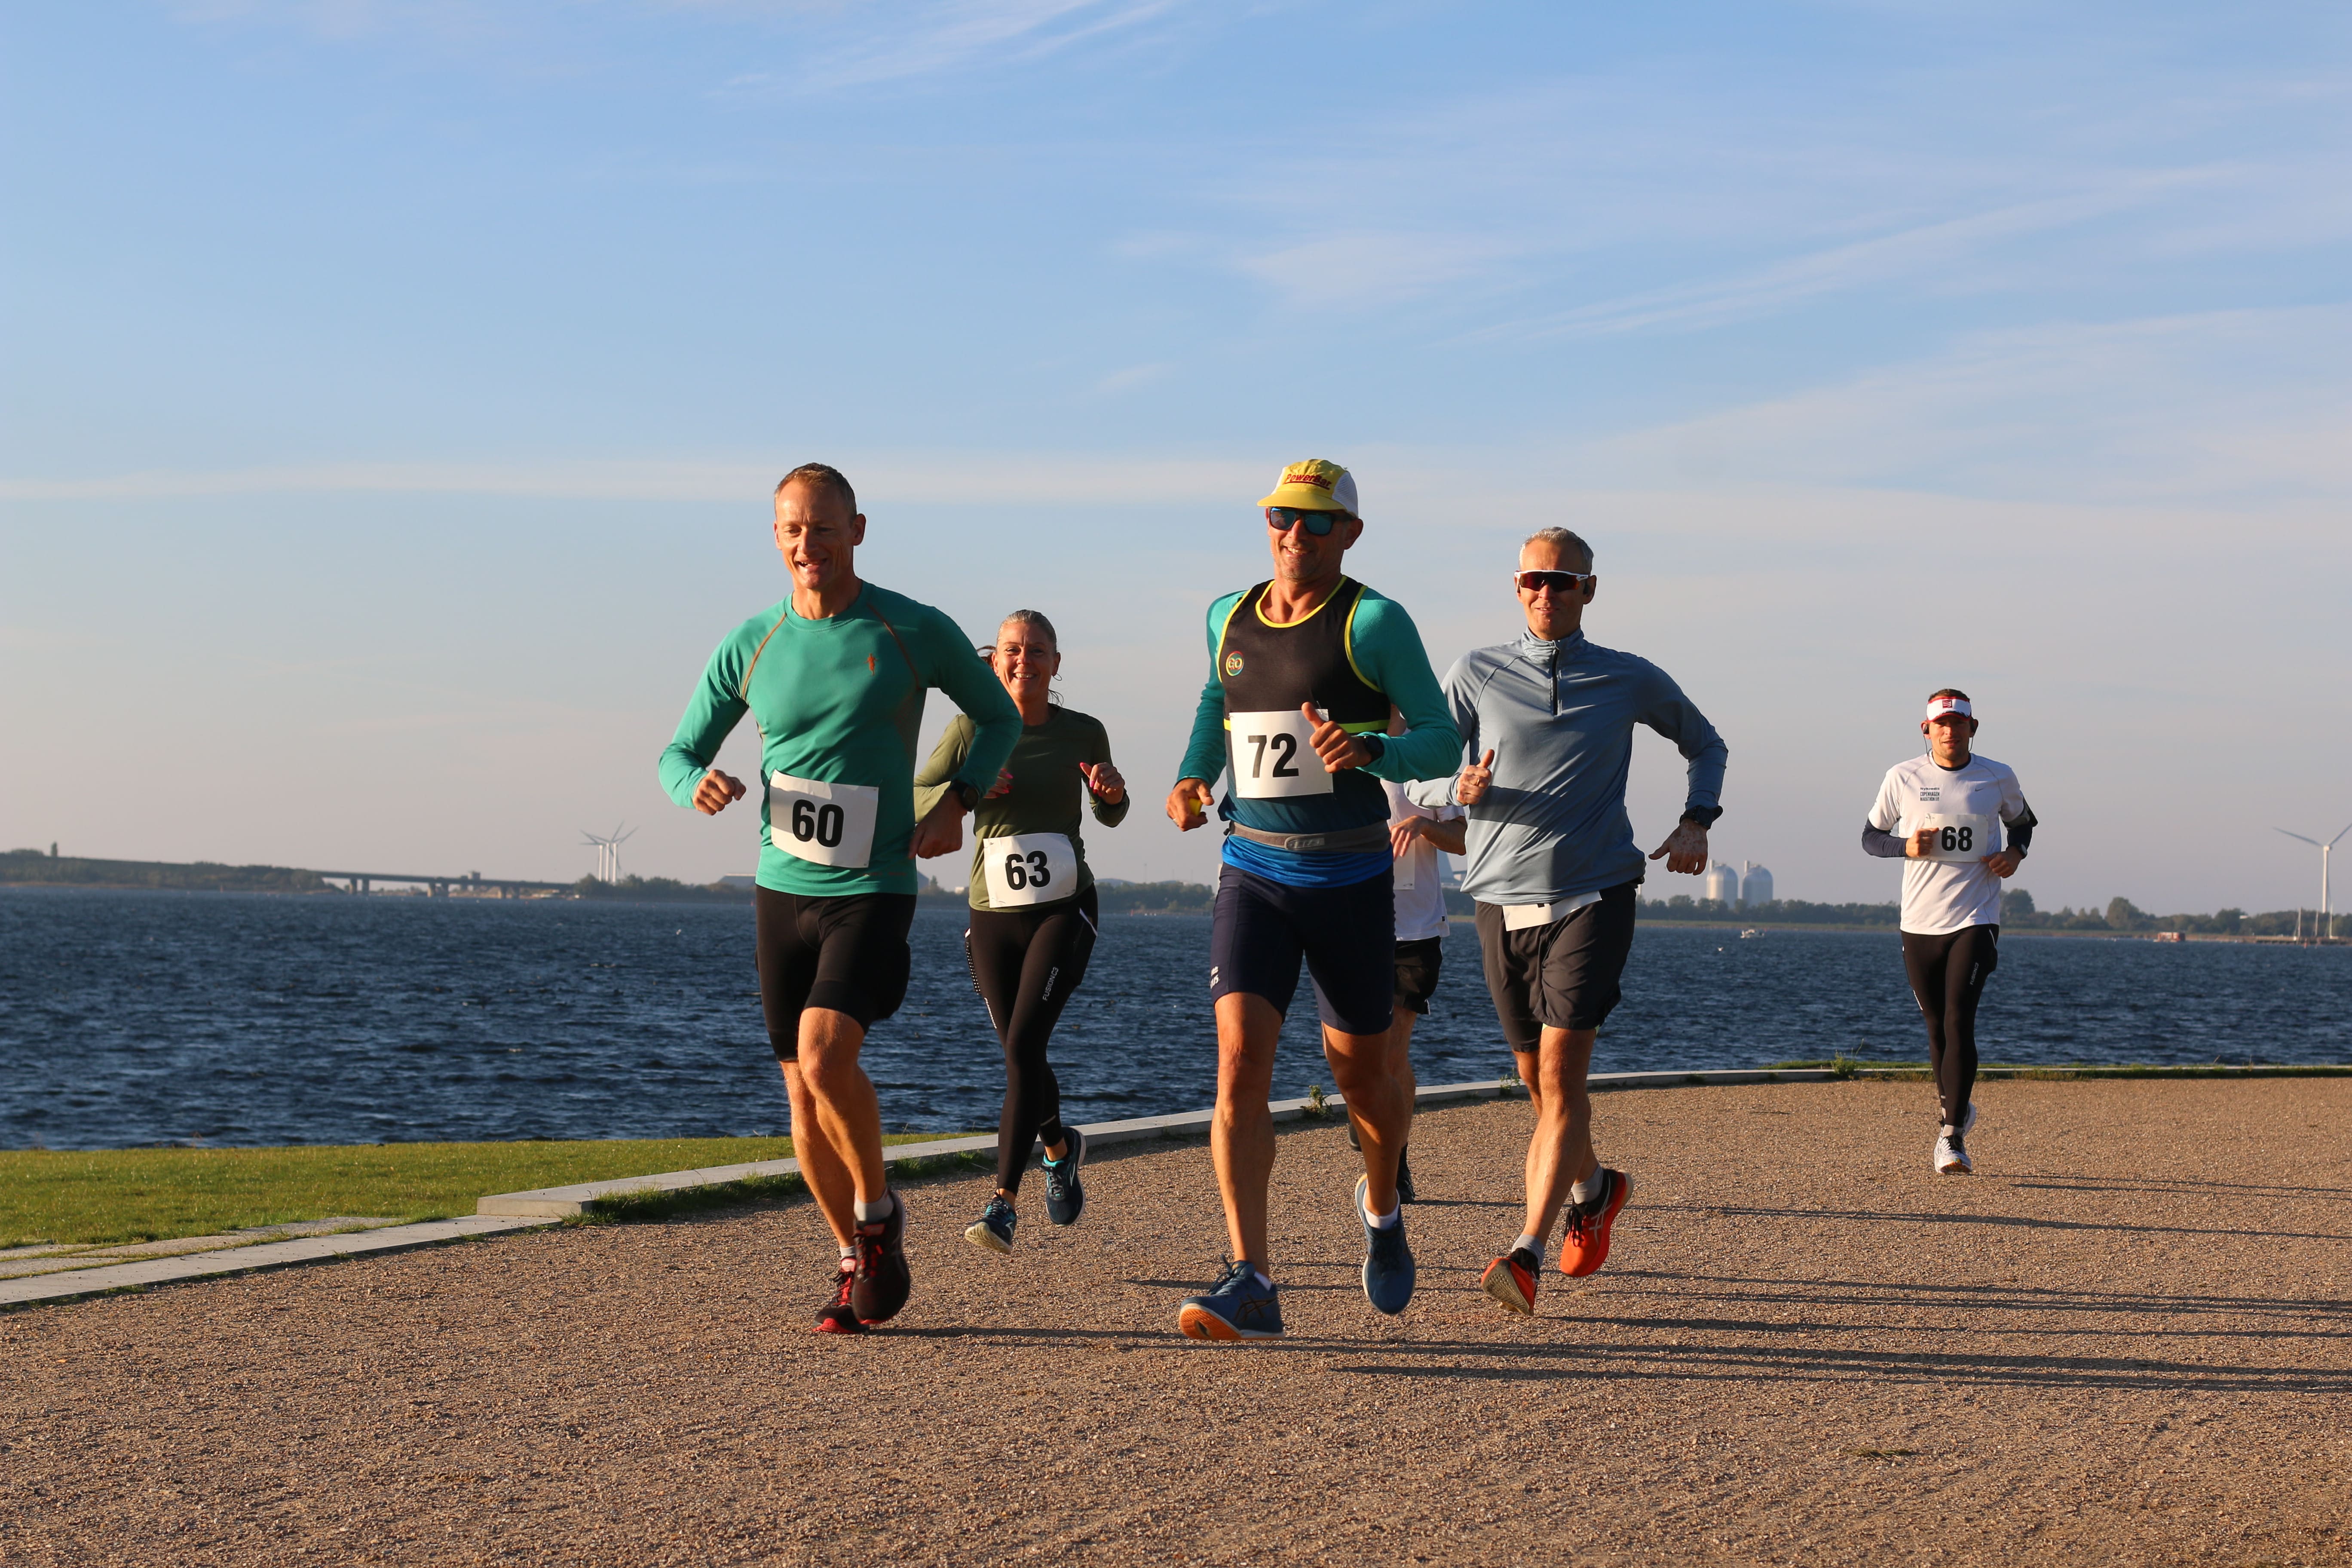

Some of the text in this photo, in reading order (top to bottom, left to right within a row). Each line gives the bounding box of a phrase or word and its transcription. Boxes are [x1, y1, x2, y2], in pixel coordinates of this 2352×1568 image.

[1286, 473, 1332, 487] PowerBar
[1248, 733, 1299, 778] 72
[792, 799, 844, 848] 60
[1941, 826, 1972, 852] 68
[1005, 850, 1050, 890] 63
